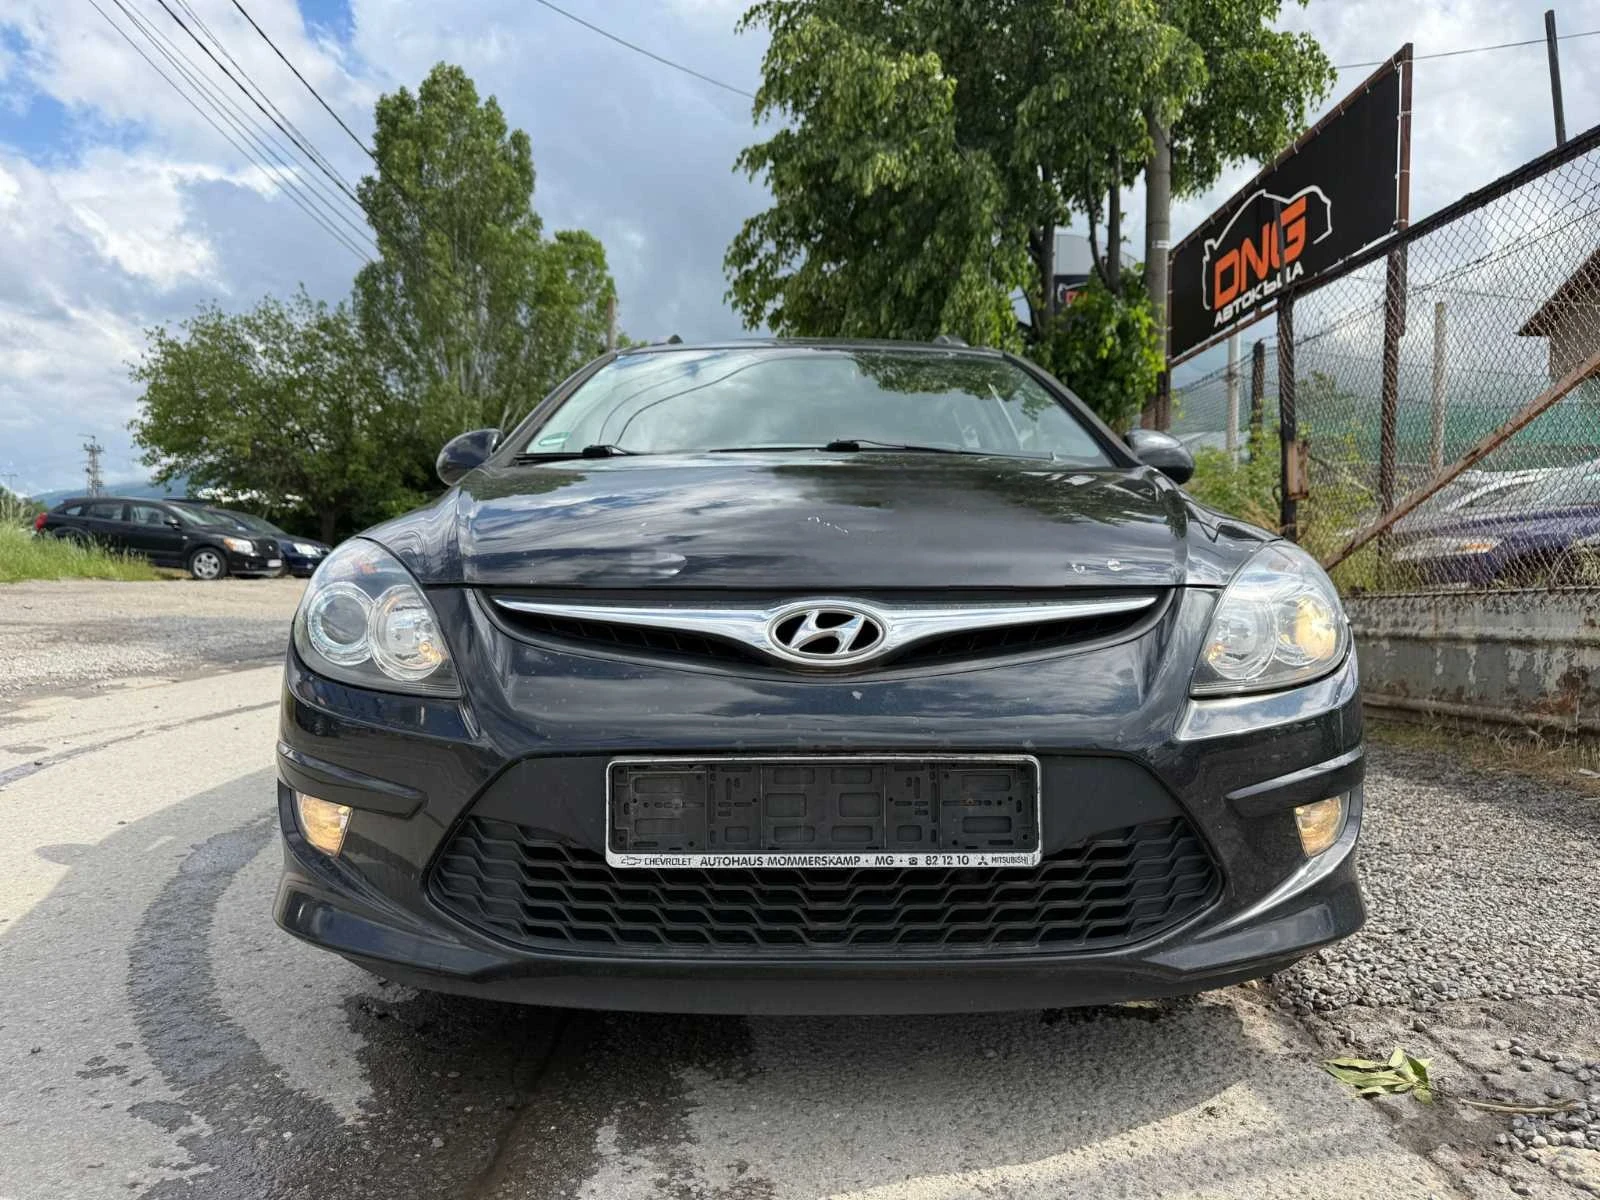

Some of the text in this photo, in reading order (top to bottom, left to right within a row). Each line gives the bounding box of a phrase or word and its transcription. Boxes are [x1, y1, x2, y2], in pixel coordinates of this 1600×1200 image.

[1214, 196, 1307, 310] DNG
[643, 857, 692, 866] CHEVROLET
[700, 855, 764, 867] AUTOHAUS
[874, 855, 895, 866] MG
[925, 855, 938, 866] 82
[942, 855, 953, 866] 12
[957, 855, 970, 866] 10
[991, 856, 1030, 866] MITSUBISHI
